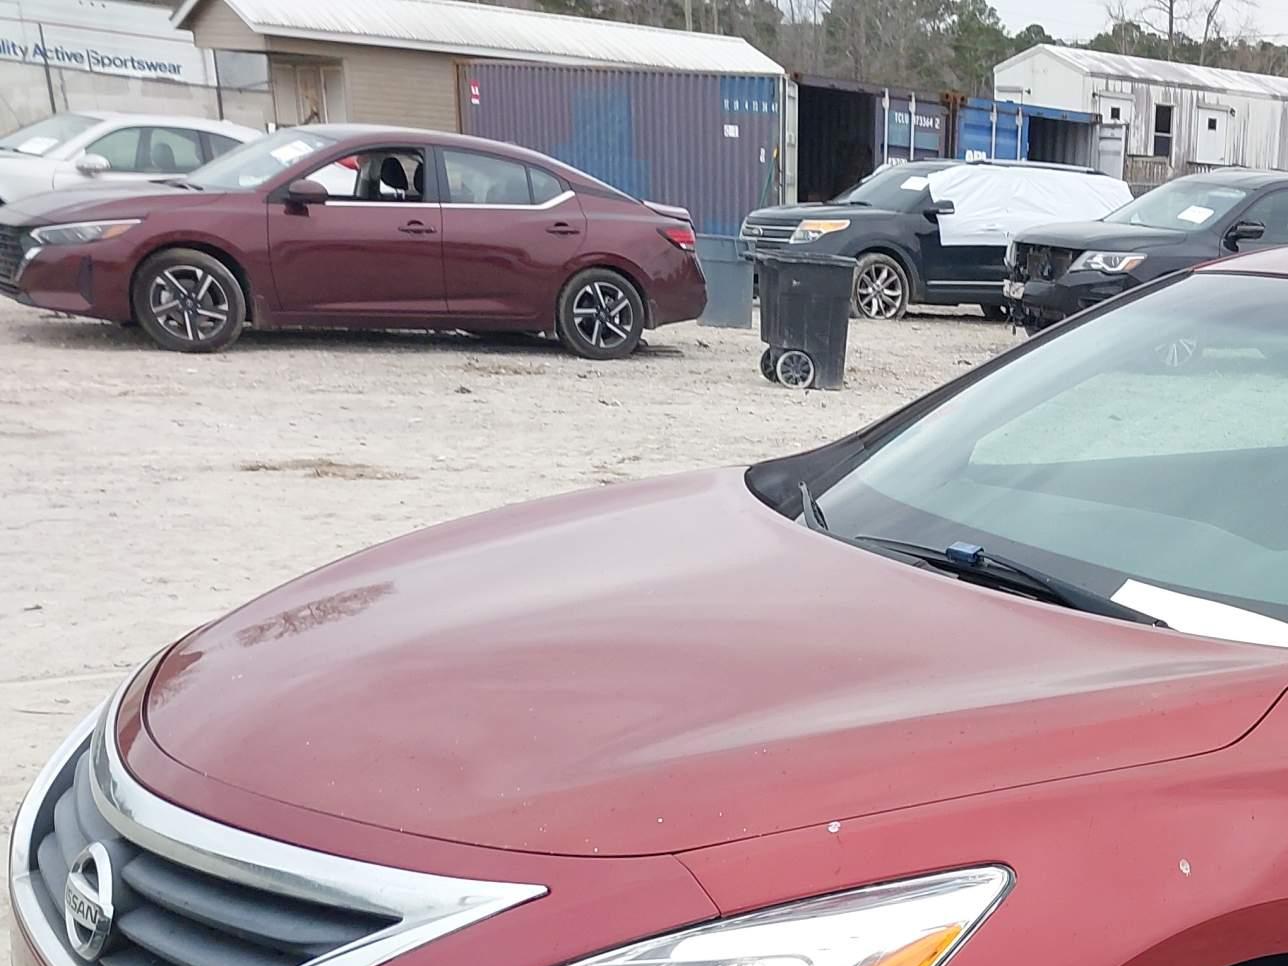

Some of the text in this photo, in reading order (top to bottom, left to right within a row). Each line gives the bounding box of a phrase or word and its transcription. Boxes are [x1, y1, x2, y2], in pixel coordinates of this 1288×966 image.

[0, 40, 183, 75] lity Active Sportswear
[65, 886, 98, 925] SSAN
